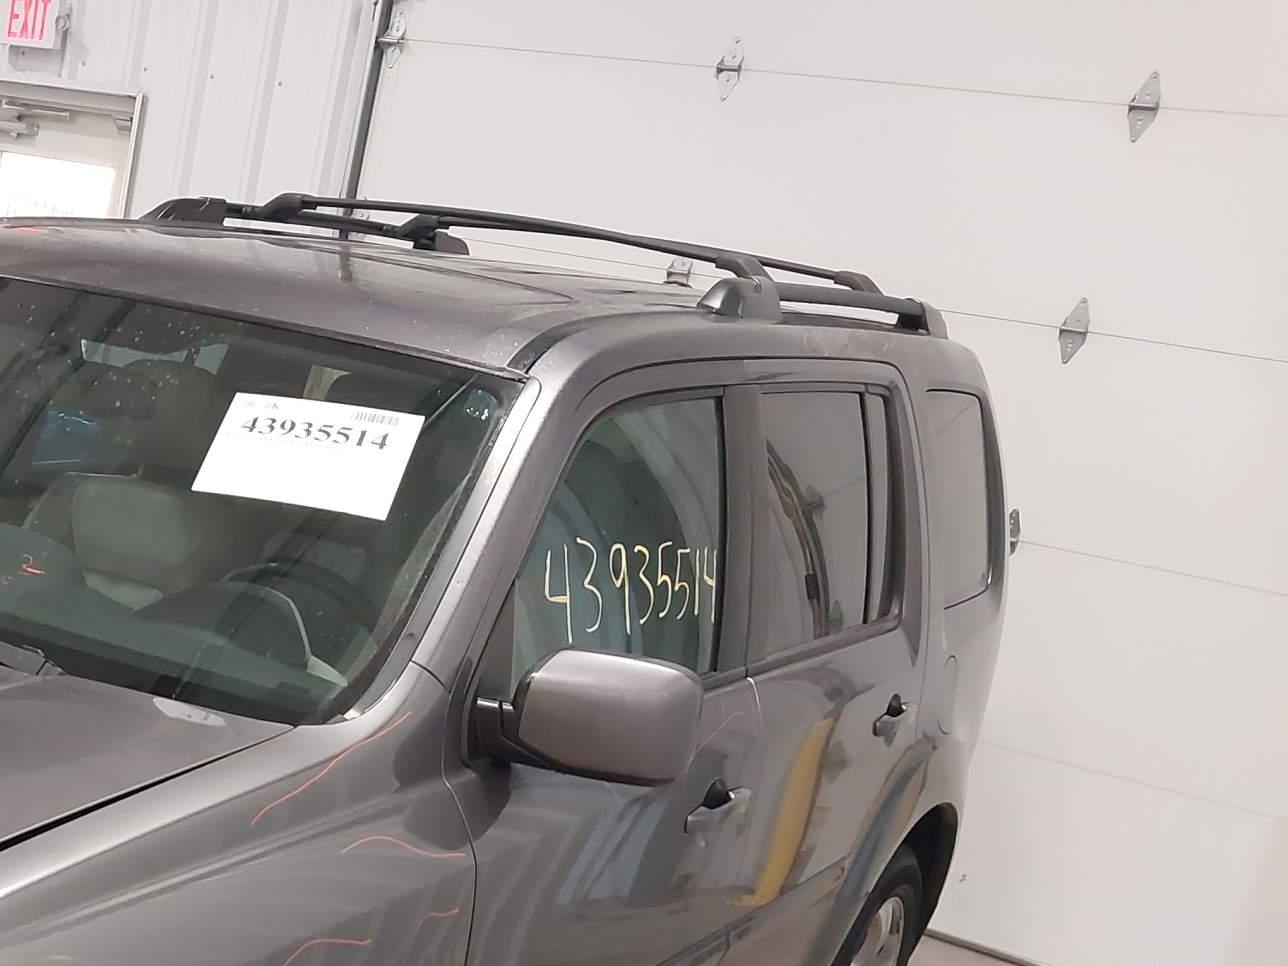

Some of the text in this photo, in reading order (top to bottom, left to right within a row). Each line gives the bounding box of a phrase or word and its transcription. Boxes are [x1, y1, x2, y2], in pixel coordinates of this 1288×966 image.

[7, 0, 51, 40] EXIT
[240, 415, 389, 450] 43935514
[544, 536, 719, 645] 43935514
